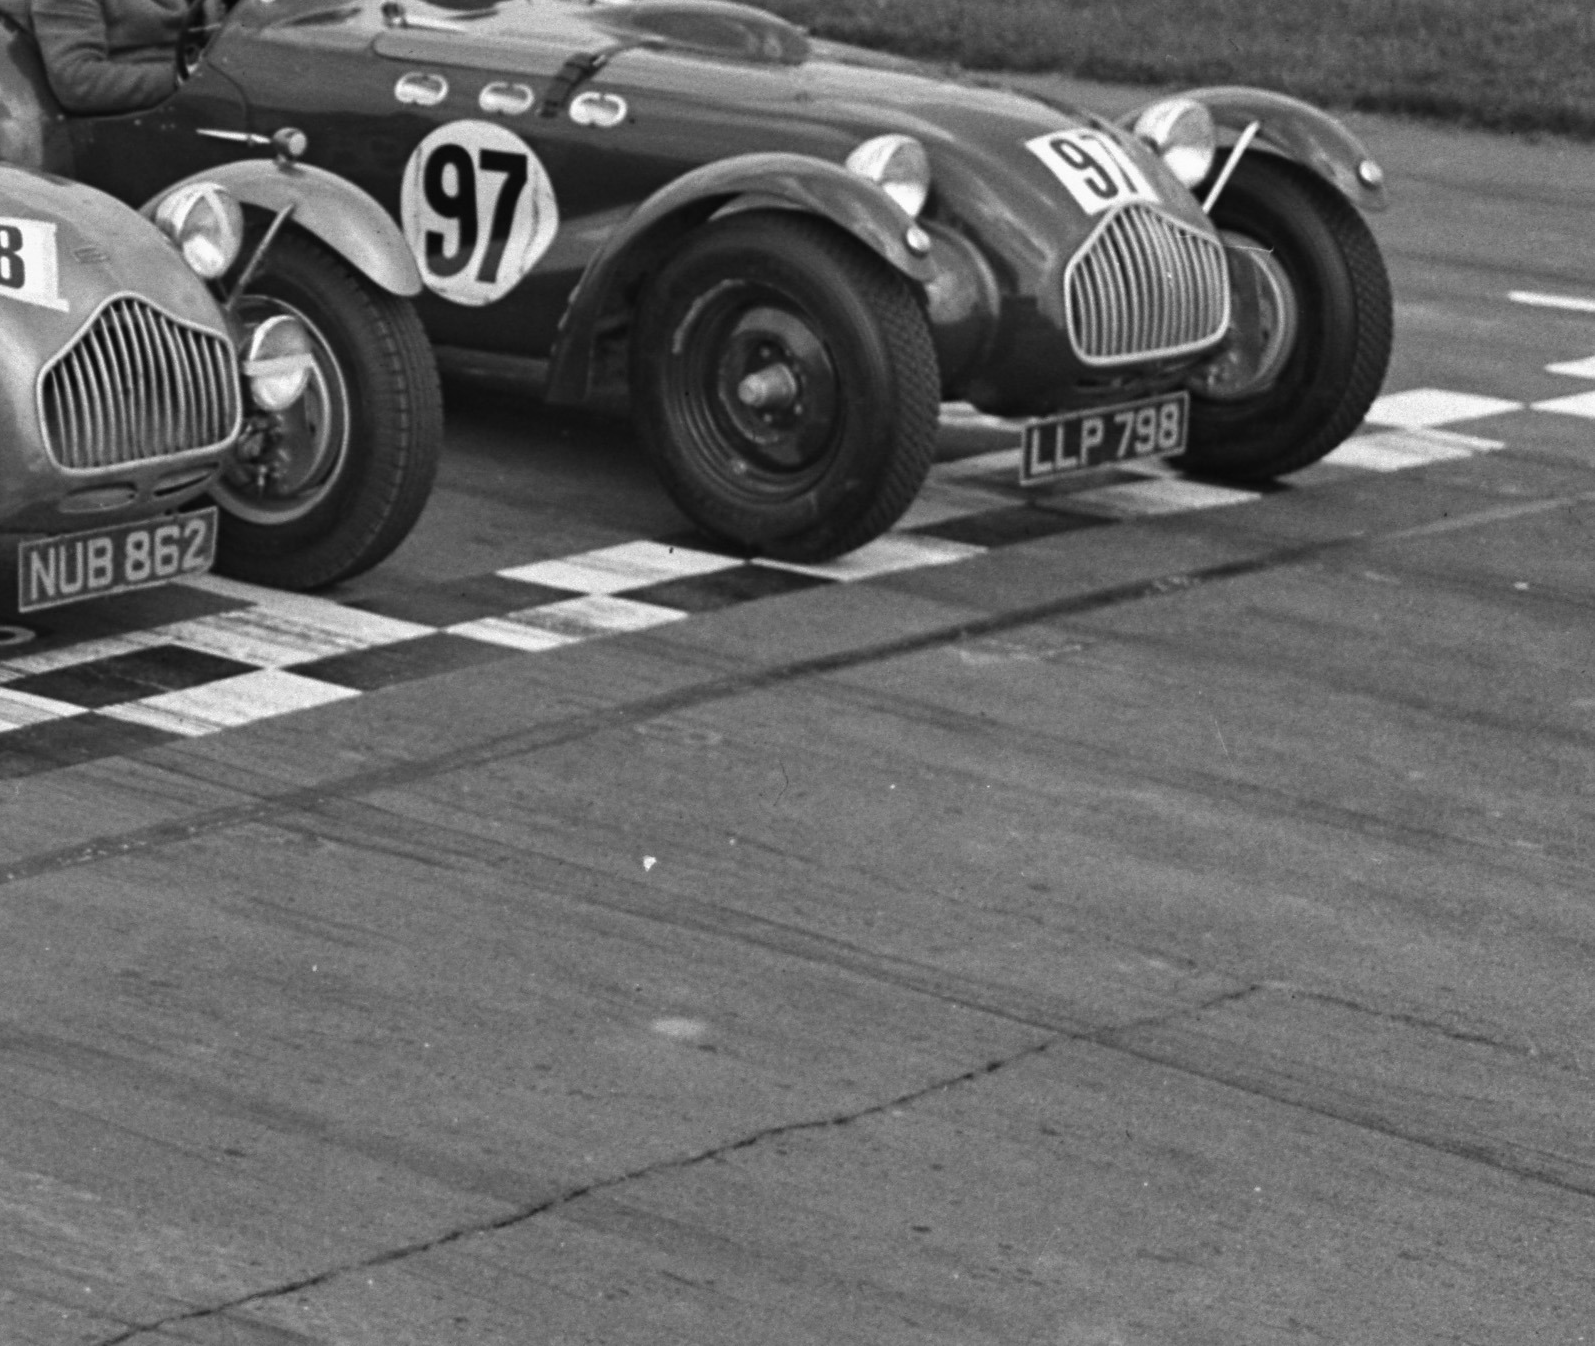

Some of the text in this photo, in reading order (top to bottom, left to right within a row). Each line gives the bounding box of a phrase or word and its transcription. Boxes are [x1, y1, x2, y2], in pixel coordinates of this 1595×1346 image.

[1049, 134, 1140, 202] 97
[423, 142, 529, 287] 97
[1030, 403, 1180, 475] LLP 798
[29, 518, 209, 602] NUB 862
